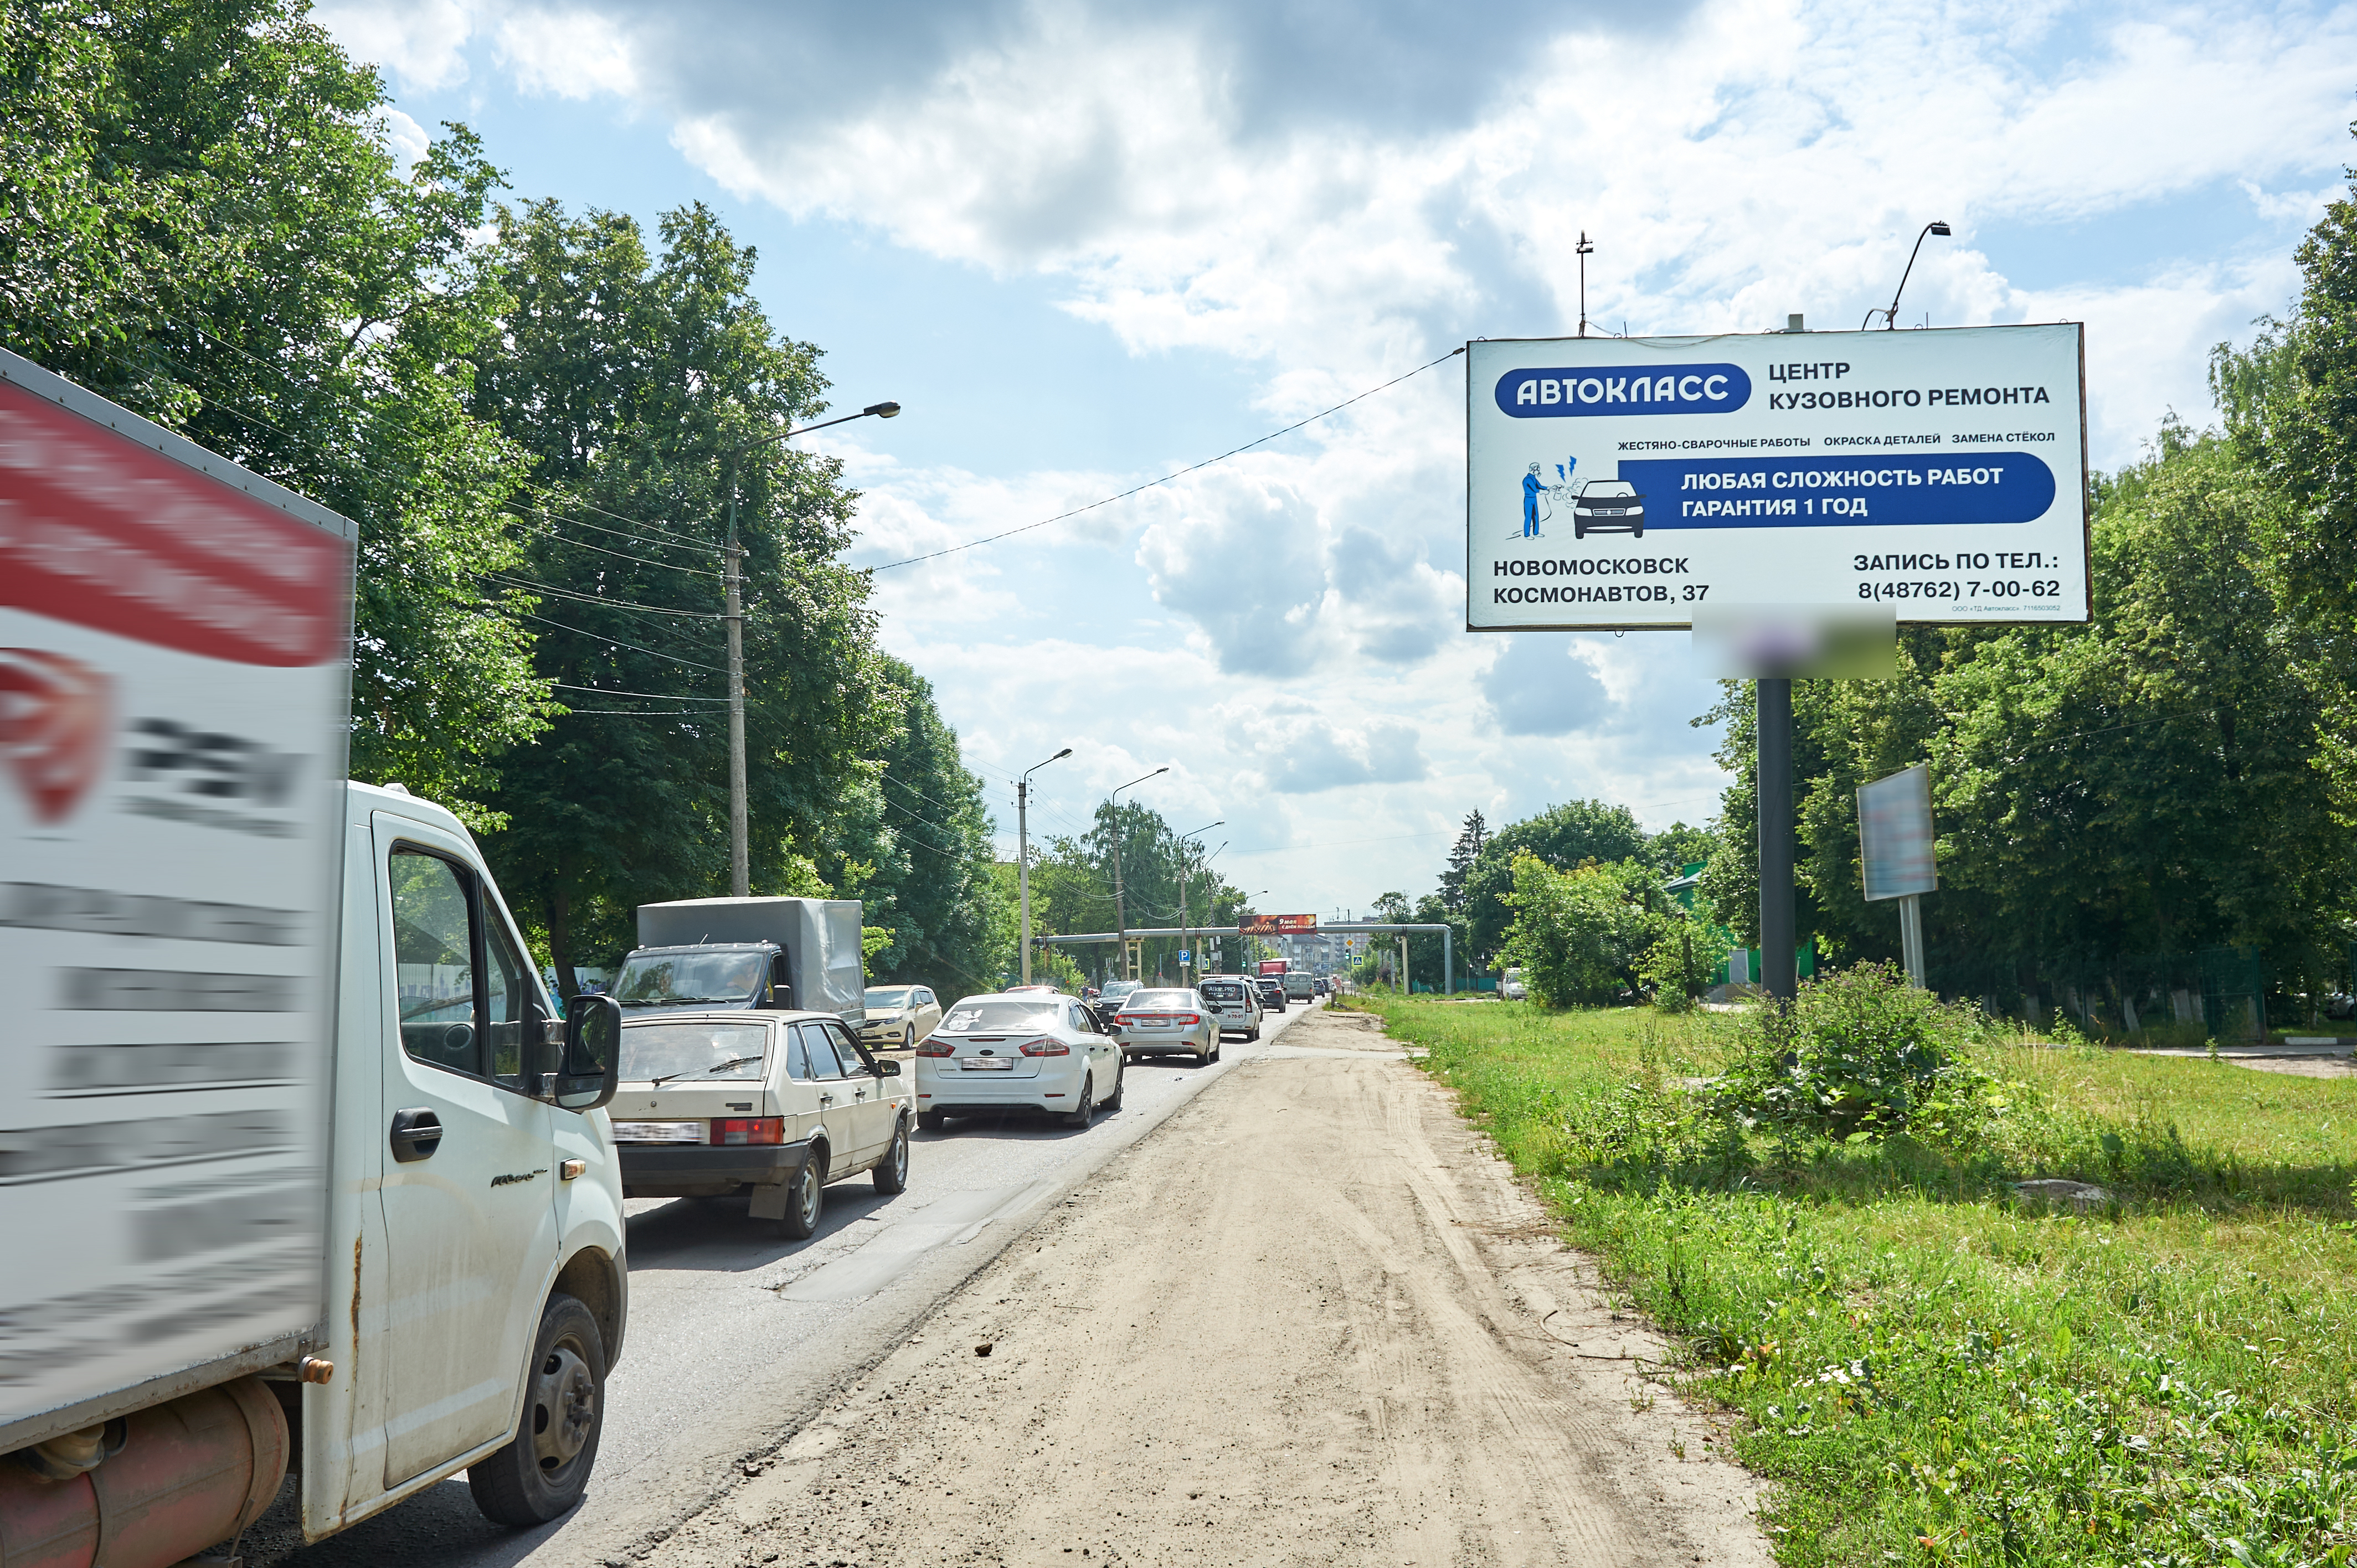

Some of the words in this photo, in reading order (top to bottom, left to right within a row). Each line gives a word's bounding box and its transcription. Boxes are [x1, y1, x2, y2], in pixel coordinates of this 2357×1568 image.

[1769, 362, 1850, 384] ЦЕНТР
[1517, 374, 1728, 405] АВТОКЛАСС
[1770, 389, 1921, 410] КУЗОВНОГО
[1928, 386, 2050, 406] РЕМОНТА
[1618, 439, 1758, 451] ЖЕСТЯНО-СВАРОЧНЫЕ
[1761, 438, 1810, 447] РАБОТЫ
[1824, 436, 1881, 446] ОКРАСКА
[1883, 435, 1941, 446] ДЕТАЛЕЙ
[1952, 434, 2004, 443] ЗАМЕНА
[2006, 432, 2055, 442] СТЁКОЛ
[1681, 472, 1766, 490] ЛЮБАЯ
[1772, 470, 1922, 488] СЛОЖНОСТЬ
[1928, 468, 2004, 485] РАБОТ
[1682, 499, 1796, 517] ГАРАНТИЯ
[1804, 498, 1813, 514] 1
[1822, 498, 1868, 517] ГОД
[1494, 558, 1689, 576] НОВОМОСКОВСК
[1854, 554, 1949, 571] ЗАПИСЬ
[1957, 553, 1989, 569] ПО
[1995, 553, 2058, 569] ТЕЛ.:
[1494, 585, 1675, 605] КОСМОНАВТОВ,
[1682, 585, 1709, 601] 37
[1859, 581, 1960, 602] 8(48762)
[1967, 580, 2060, 597] 7-00-62
